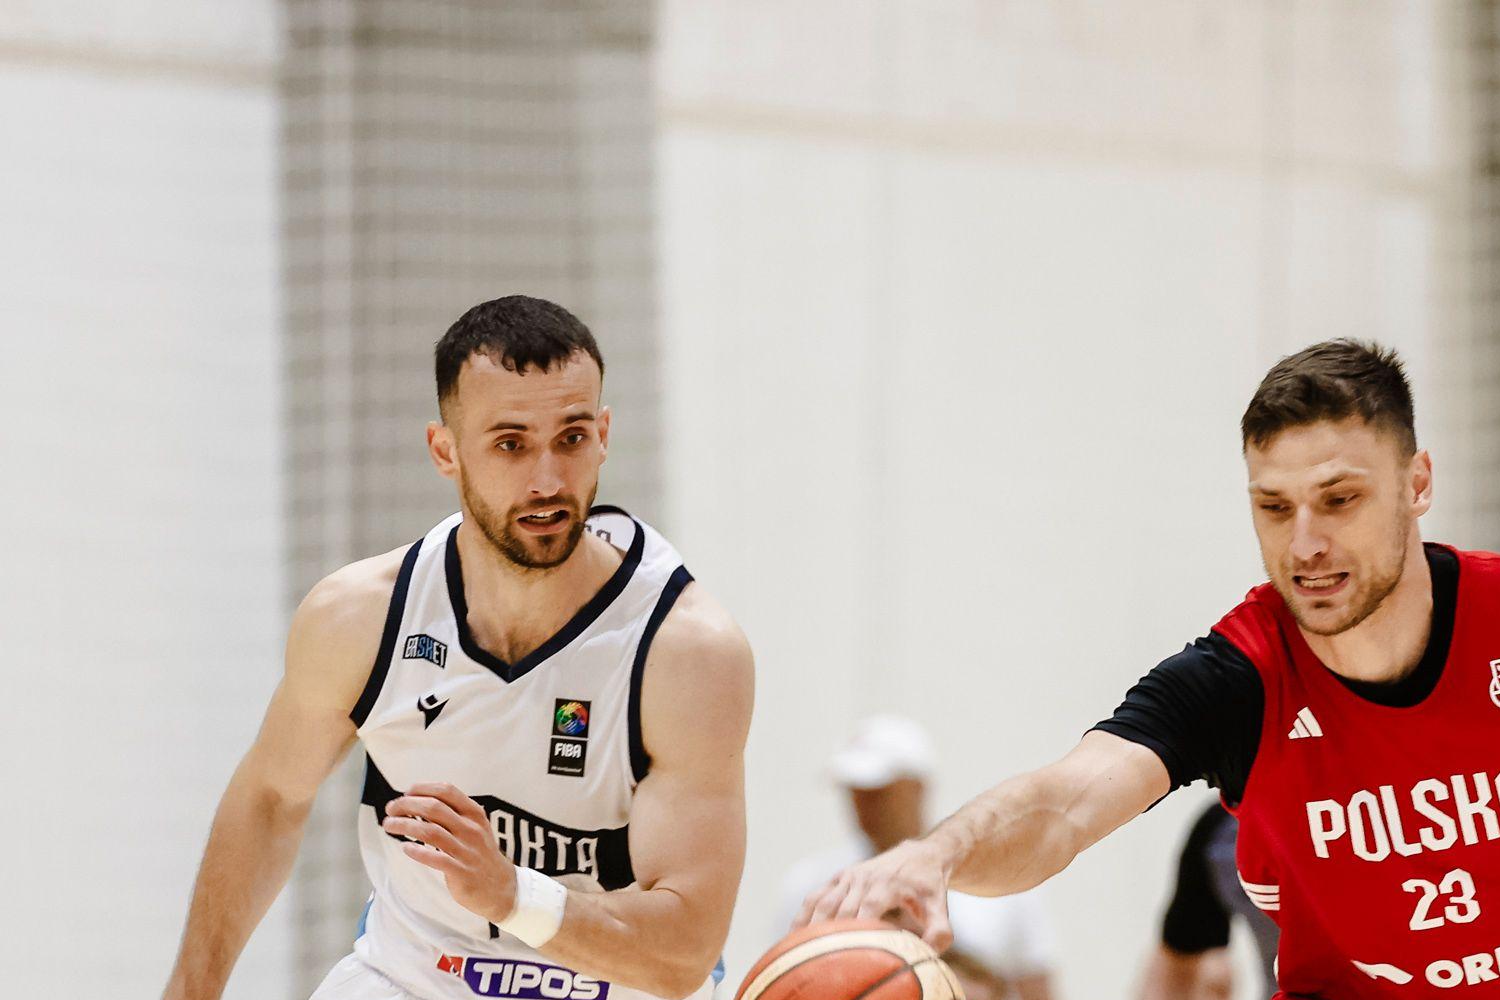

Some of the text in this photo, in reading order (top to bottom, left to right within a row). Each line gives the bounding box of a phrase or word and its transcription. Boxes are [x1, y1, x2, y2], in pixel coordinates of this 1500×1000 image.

[554, 742, 582, 759] FIBA
[1401, 868, 1482, 931] 23
[473, 961, 601, 1000] TIPOS
